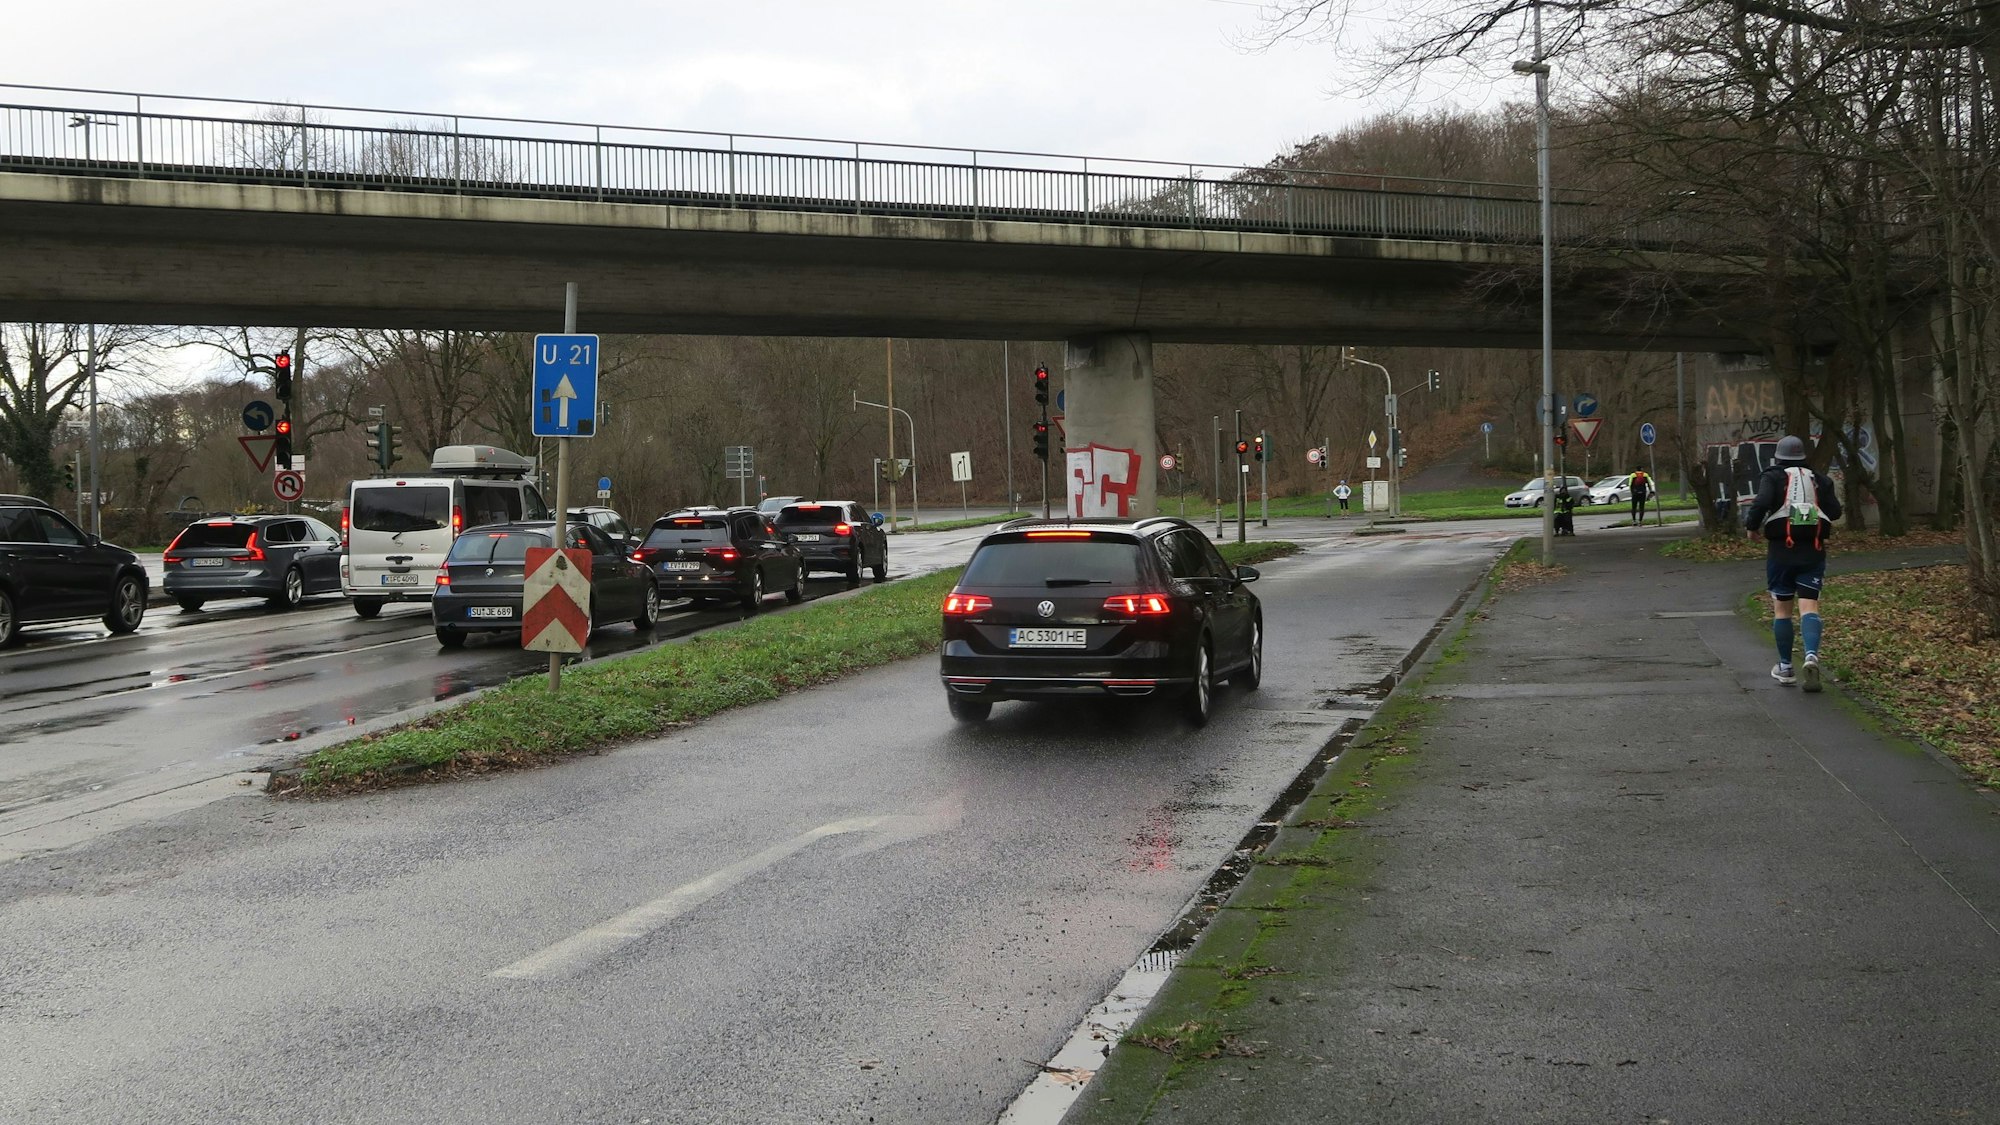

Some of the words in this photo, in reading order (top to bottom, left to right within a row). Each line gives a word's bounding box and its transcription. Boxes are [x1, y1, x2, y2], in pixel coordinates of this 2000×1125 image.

[543, 344, 557, 365] U
[570, 344, 590, 365] 21
[497, 608, 511, 616] 689
[1018, 630, 1034, 642] AC
[1037, 630, 1063, 642] 5301
[1067, 630, 1083, 642] HE
